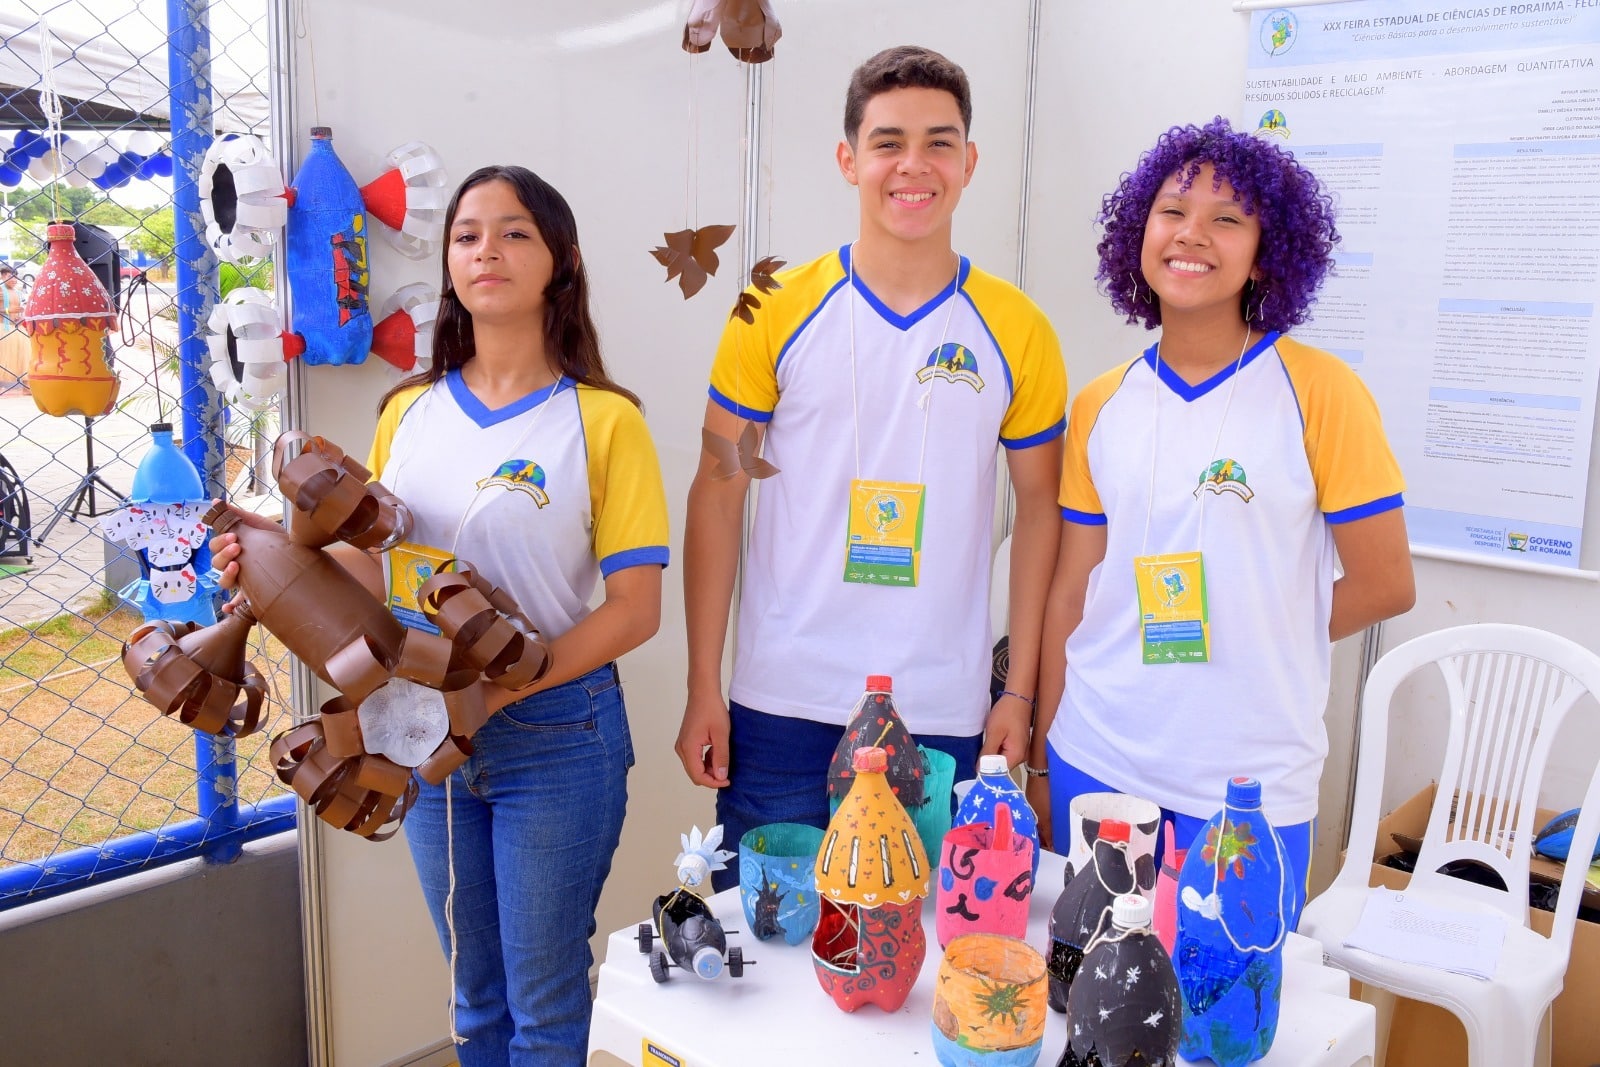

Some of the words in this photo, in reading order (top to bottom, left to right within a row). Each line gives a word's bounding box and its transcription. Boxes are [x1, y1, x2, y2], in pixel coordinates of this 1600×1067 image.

[1323, 22, 1341, 32] XXX
[1343, 19, 1370, 30] FEIRA
[1373, 14, 1424, 28] ESTADUAL
[1426, 13, 1439, 23] DE
[1442, 8, 1490, 21] CIÊNCIAS
[1492, 7, 1507, 17] DE
[1510, 1, 1564, 15] RORAIMA
[1574, 0, 1600, 9] FECI
[1387, 30, 1416, 40] Básicas
[1418, 28, 1437, 38] para
[1446, 21, 1519, 35] desenvolvimento
[1246, 76, 1323, 89] SUSTENTABILIDADE
[1331, 75, 1336, 84] E
[1344, 73, 1368, 83] MEIO
[1376, 69, 1423, 81] AMBIENTE
[1444, 63, 1507, 76] ABORDAGEM
[1517, 57, 1594, 72] QUANTITATIVA
[1245, 91, 1285, 102] RESÍDUOS
[1286, 88, 1321, 100] SÓLIDOS
[1322, 89, 1328, 98] E
[1470, 533, 1498, 541] EDUCAÇÃO
[1529, 536, 1573, 549] GOVERNO
[1474, 540, 1501, 549] DESPORTO
[1539, 546, 1572, 557] RORAIMA
